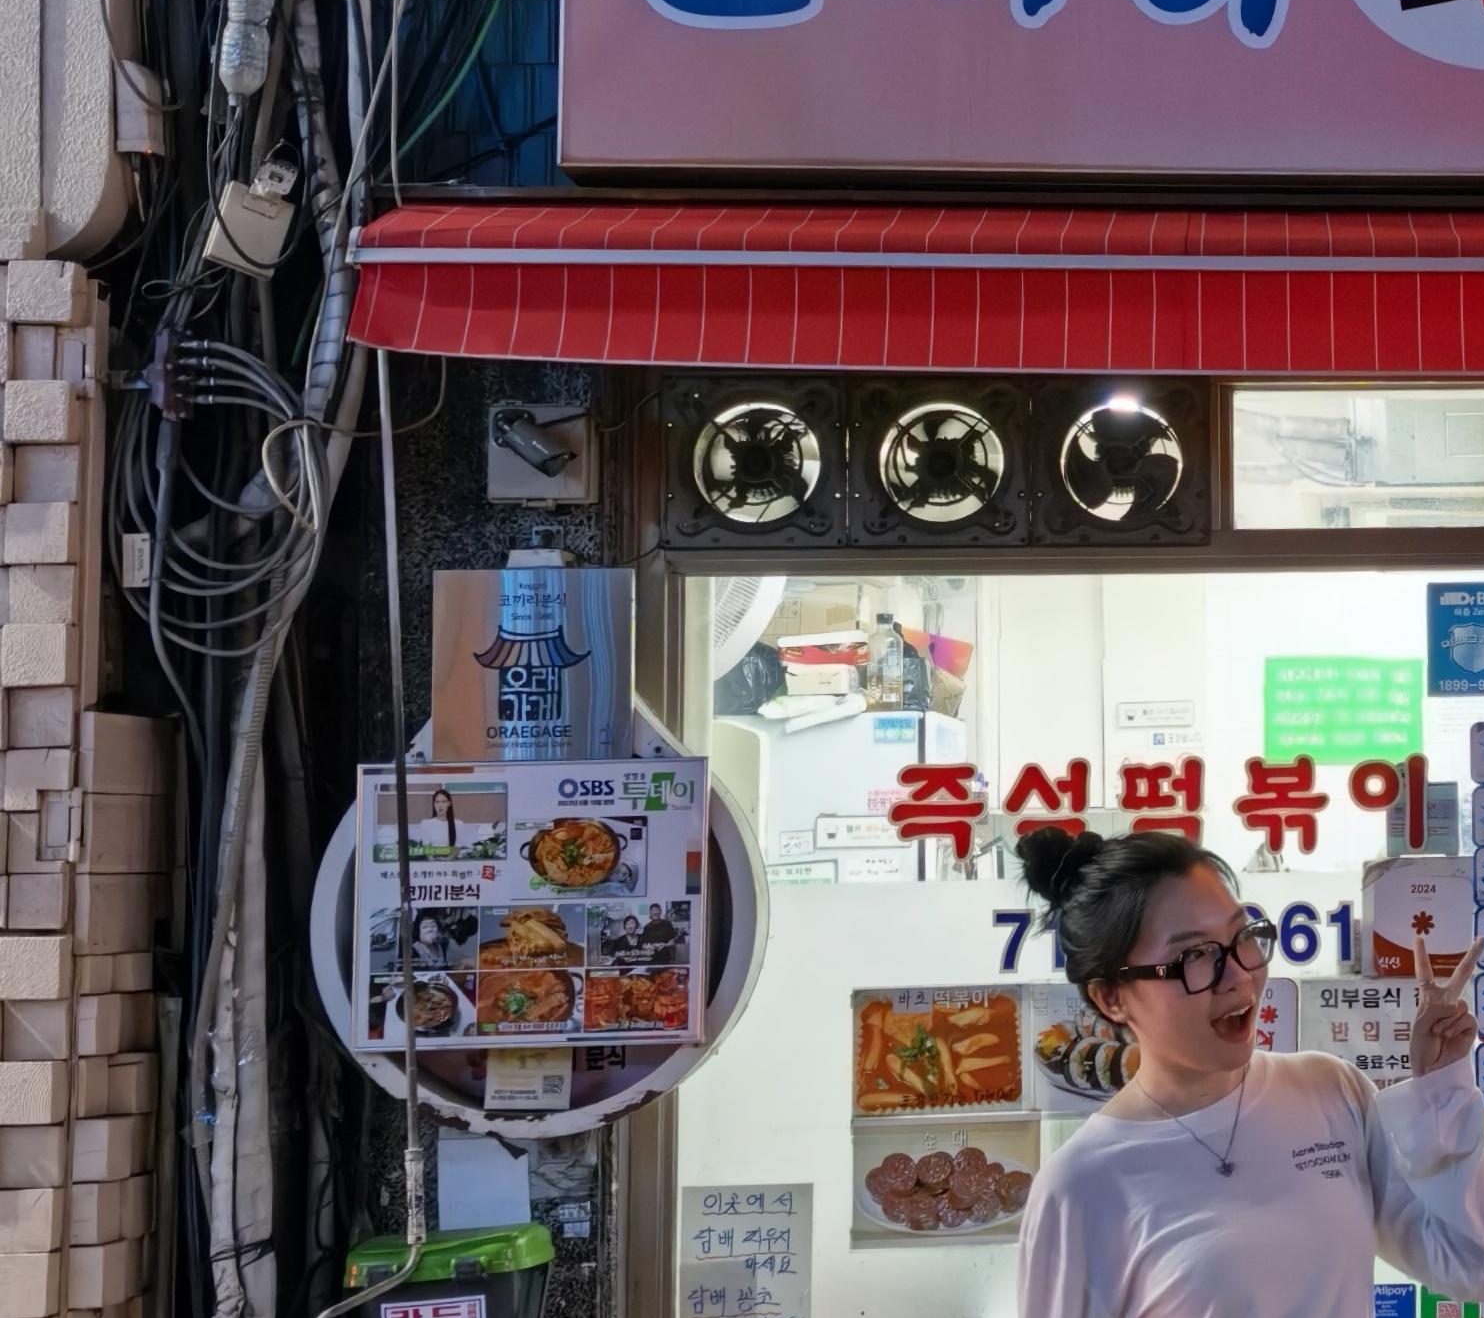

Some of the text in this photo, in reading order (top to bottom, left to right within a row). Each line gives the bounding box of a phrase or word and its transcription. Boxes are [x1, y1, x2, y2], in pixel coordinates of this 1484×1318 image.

[503, 667, 560, 691] 오래
[486, 725, 572, 738] ORAEGAGE
[579, 780, 614, 796] SBS
[1411, 884, 1436, 894] 2024
[933, 990, 989, 1009] 떡볶이
[1320, 987, 1401, 1009] 외부음식
